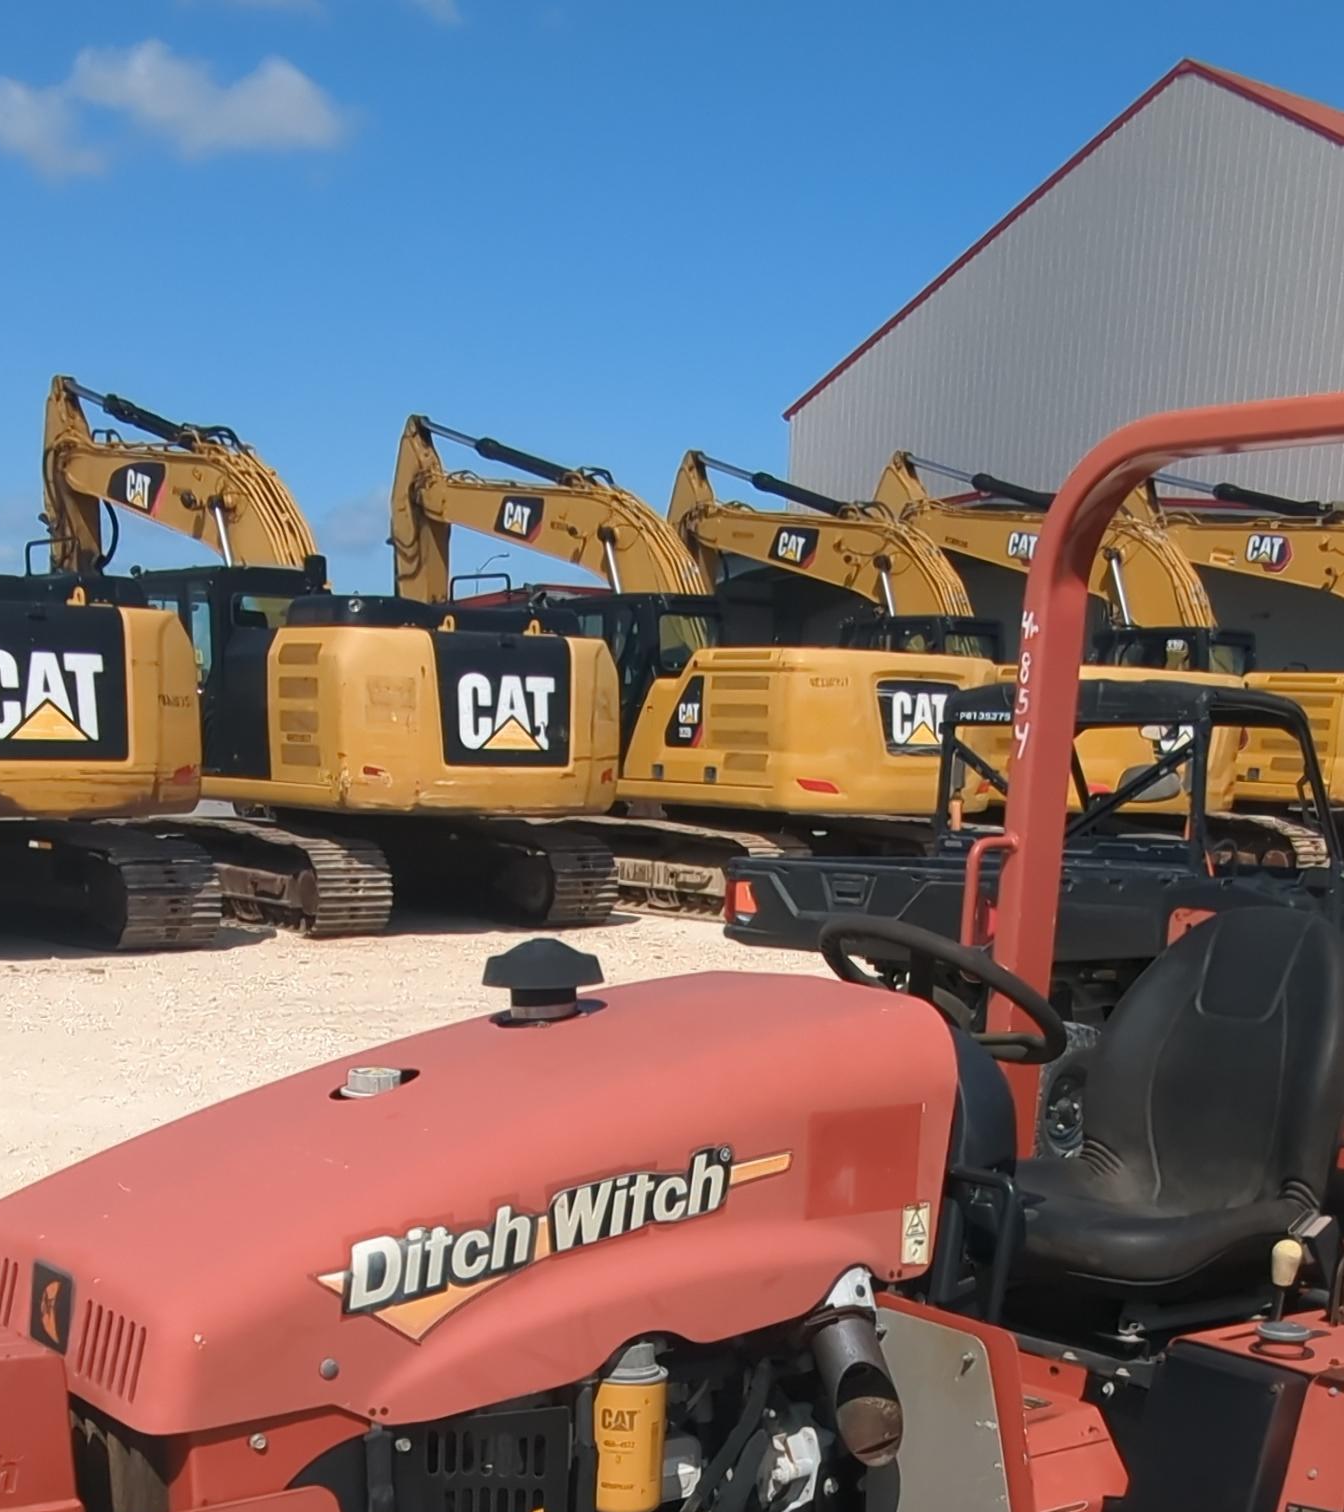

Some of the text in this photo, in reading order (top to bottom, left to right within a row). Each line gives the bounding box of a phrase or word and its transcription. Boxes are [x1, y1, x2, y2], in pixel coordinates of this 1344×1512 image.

[126, 468, 151, 509] CAT
[503, 501, 531, 535] CAT
[778, 531, 806, 562] CAT
[1008, 532, 1038, 560] CAT
[1246, 535, 1284, 564] CAT
[457, 672, 556, 750] CAT
[678, 703, 699, 724] CAT
[892, 691, 948, 744] CAT
[1014, 651, 1032, 760] 854
[349, 1153, 725, 1310] Ditch Witch
[601, 1408, 637, 1432] CAT
